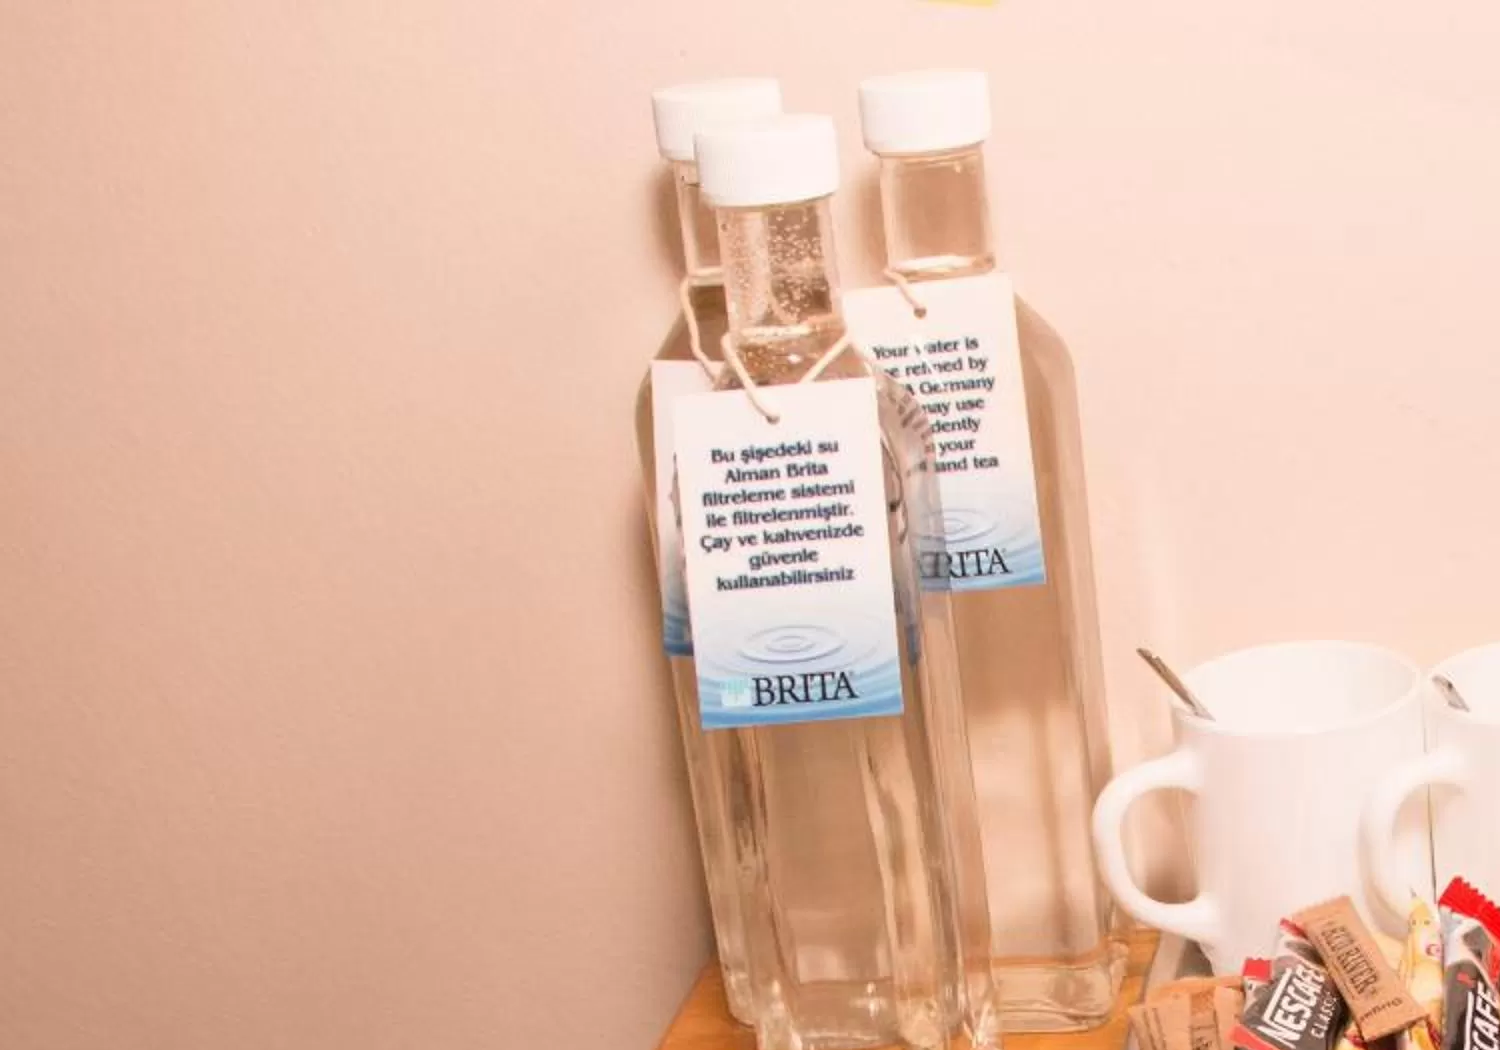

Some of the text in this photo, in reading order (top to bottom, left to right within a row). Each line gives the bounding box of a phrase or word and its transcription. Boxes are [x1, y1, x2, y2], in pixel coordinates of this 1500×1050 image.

[873, 344, 908, 360] Your
[965, 336, 979, 350] is
[968, 356, 988, 372] by
[955, 398, 984, 411] use
[711, 440, 839, 464] Bu şişedeki su
[937, 439, 975, 456] your
[724, 462, 829, 484] Alman Brita
[973, 456, 999, 469] tea
[702, 479, 856, 507] filtreleme sistemi
[706, 512, 727, 528] ile
[700, 523, 865, 553] Çay ve kahvenizde
[749, 548, 820, 571] güvenle
[716, 566, 856, 592] kullanabilirsiniz
[752, 671, 860, 706] BRITA
